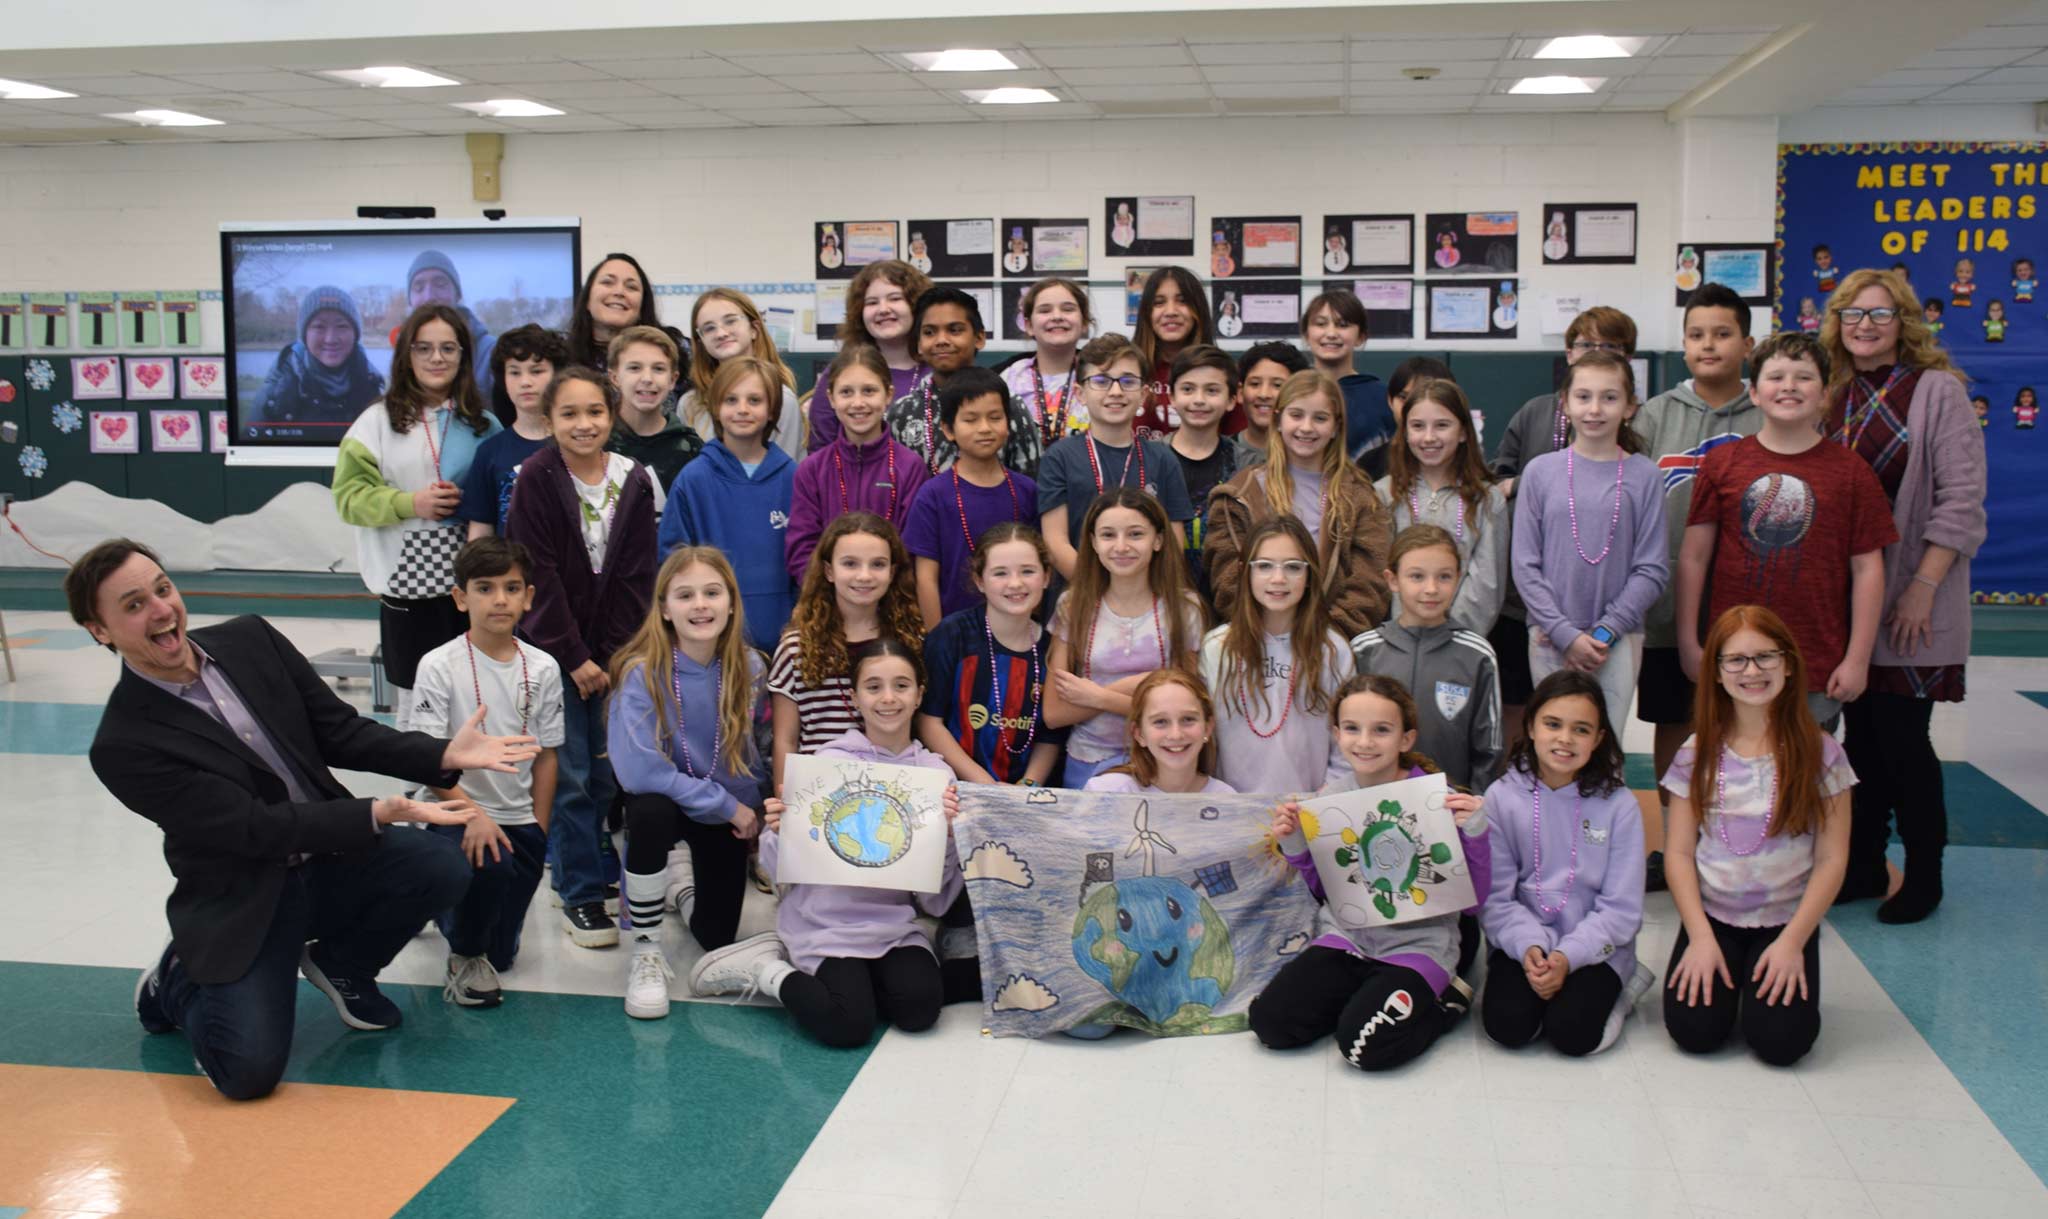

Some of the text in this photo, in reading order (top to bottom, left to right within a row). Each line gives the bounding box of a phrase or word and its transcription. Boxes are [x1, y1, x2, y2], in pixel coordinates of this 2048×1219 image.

[1856, 164, 1950, 188] MEET
[1875, 195, 2035, 222] LEADERS
[1882, 229, 2009, 254] OF 114
[990, 712, 1035, 730] Spotif
[790, 776, 826, 814] SAVE
